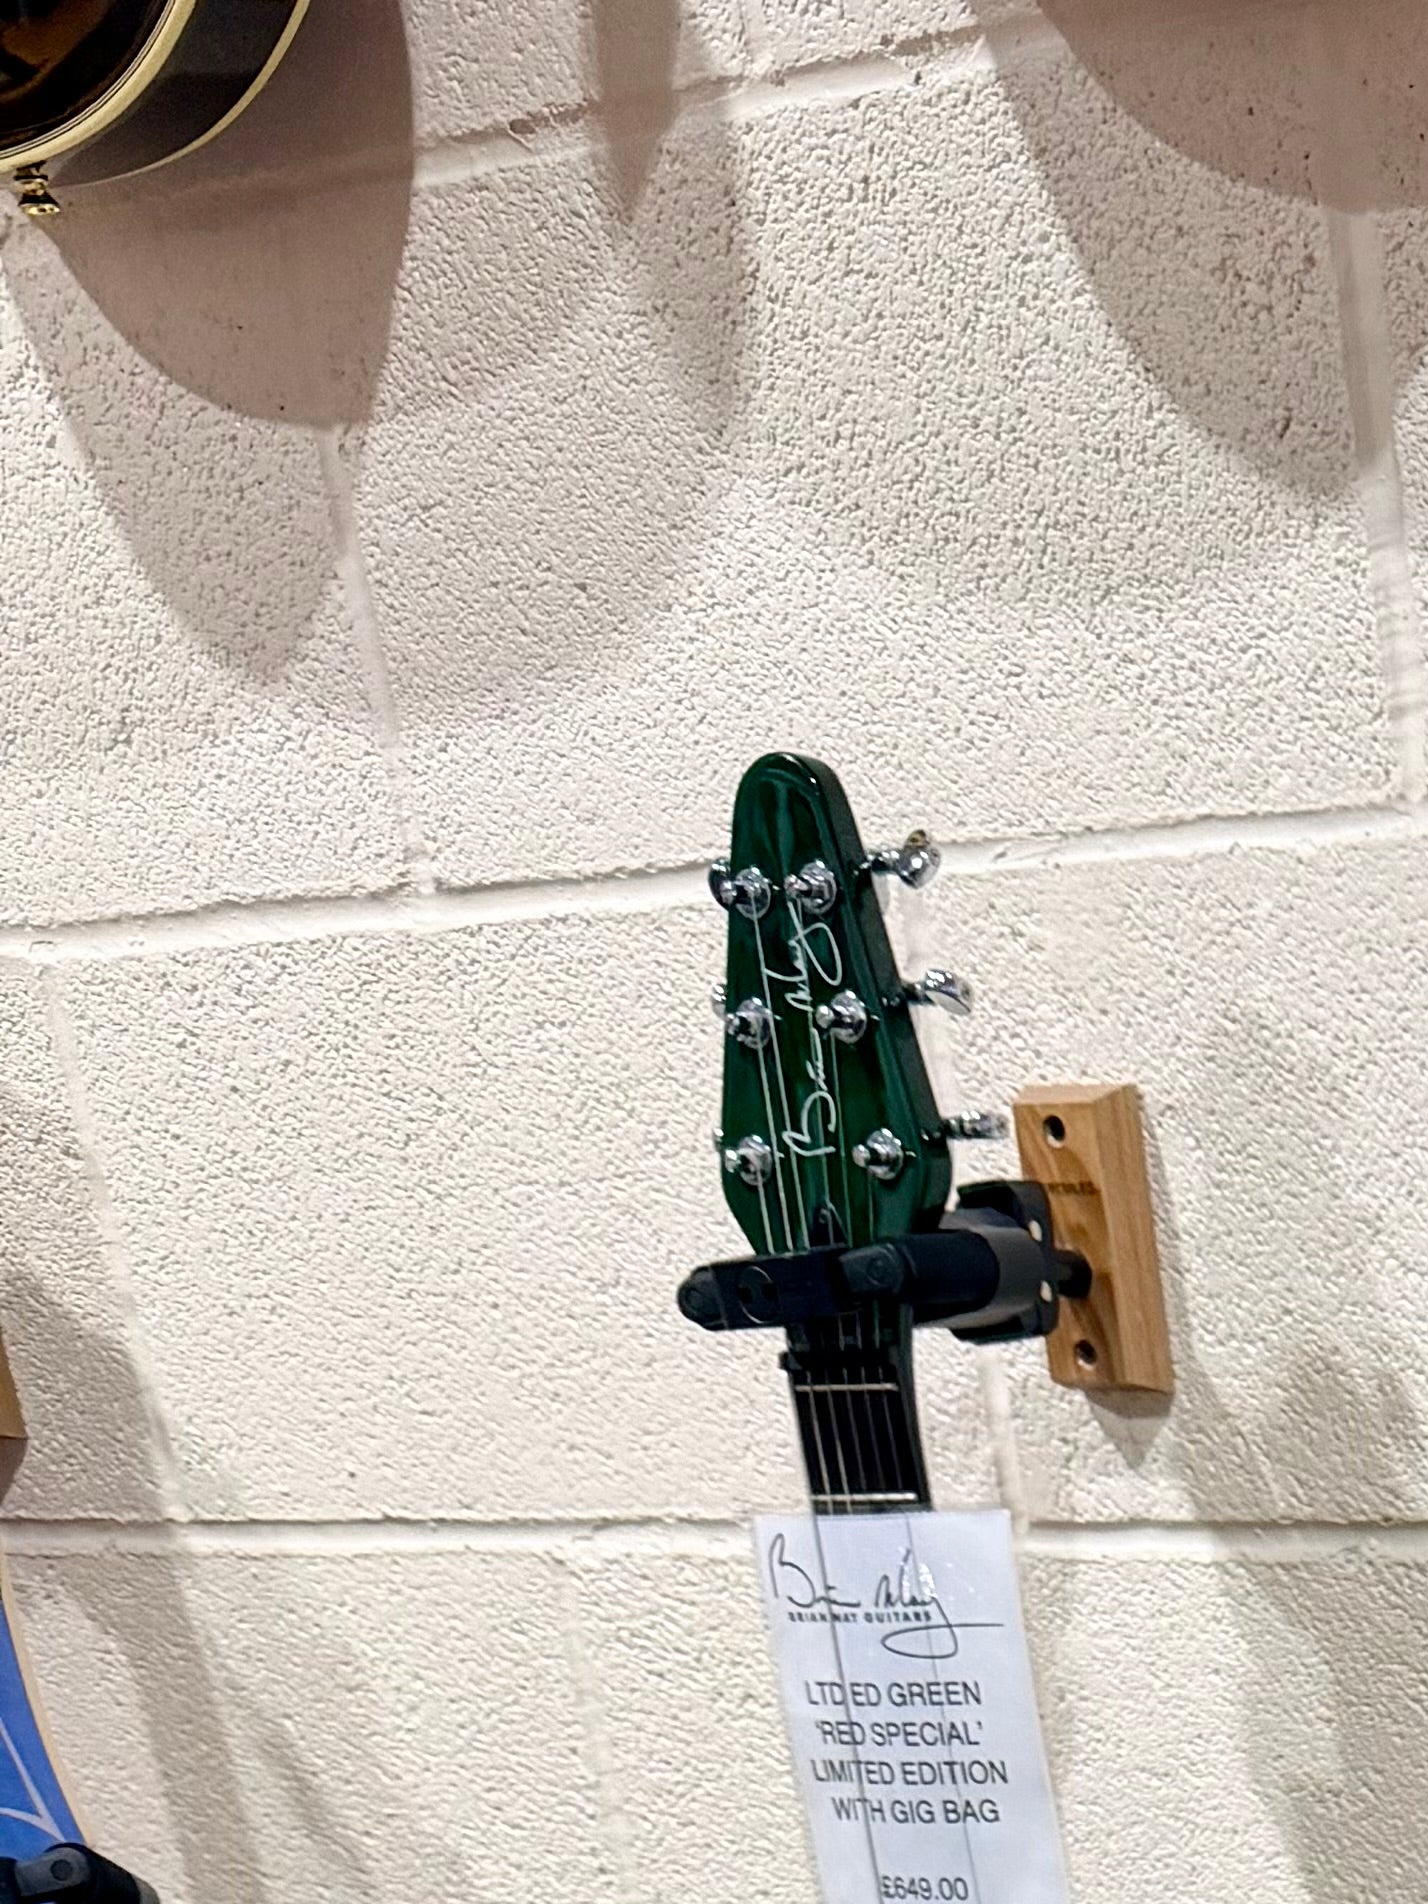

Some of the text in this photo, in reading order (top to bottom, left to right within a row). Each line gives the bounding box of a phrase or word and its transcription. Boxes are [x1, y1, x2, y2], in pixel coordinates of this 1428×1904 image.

[863, 1609, 932, 1623] GUITARS
[805, 1680, 982, 1707] LTD ED GREEN
[810, 1758, 1009, 1785] LIMITED EDITION
[831, 1796, 1000, 1824] WITH GIG BAG
[881, 1875, 970, 1902] £649.00
